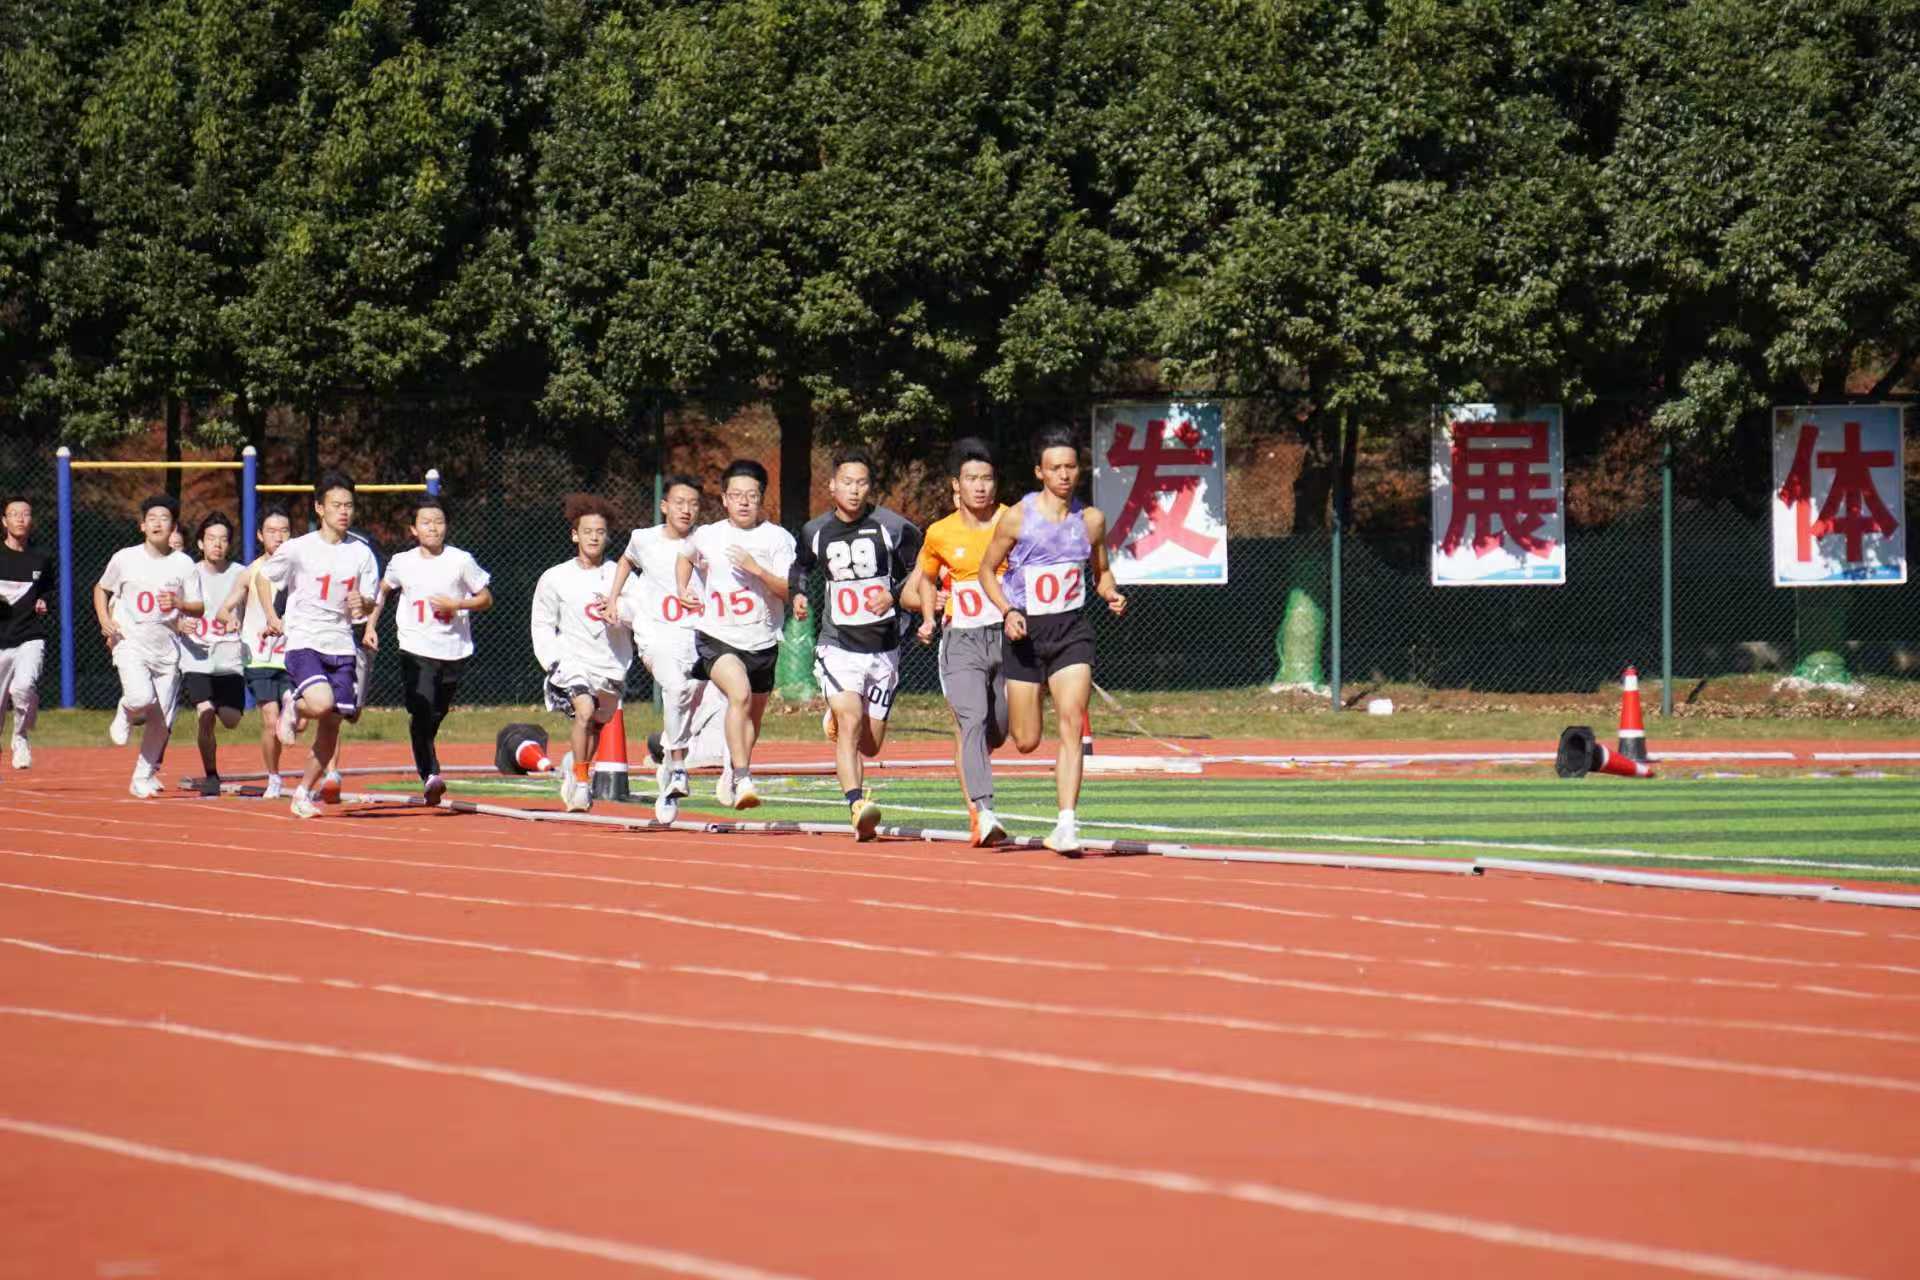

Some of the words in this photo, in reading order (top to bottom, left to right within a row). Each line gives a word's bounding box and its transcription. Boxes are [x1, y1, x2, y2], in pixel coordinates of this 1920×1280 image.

[1106, 419, 1219, 561] 发
[1440, 421, 1557, 560] 展
[1779, 422, 1899, 562] 体
[826, 538, 878, 582] 29
[711, 586, 754, 616] 15
[958, 588, 982, 617] 0
[1035, 567, 1081, 604] 02
